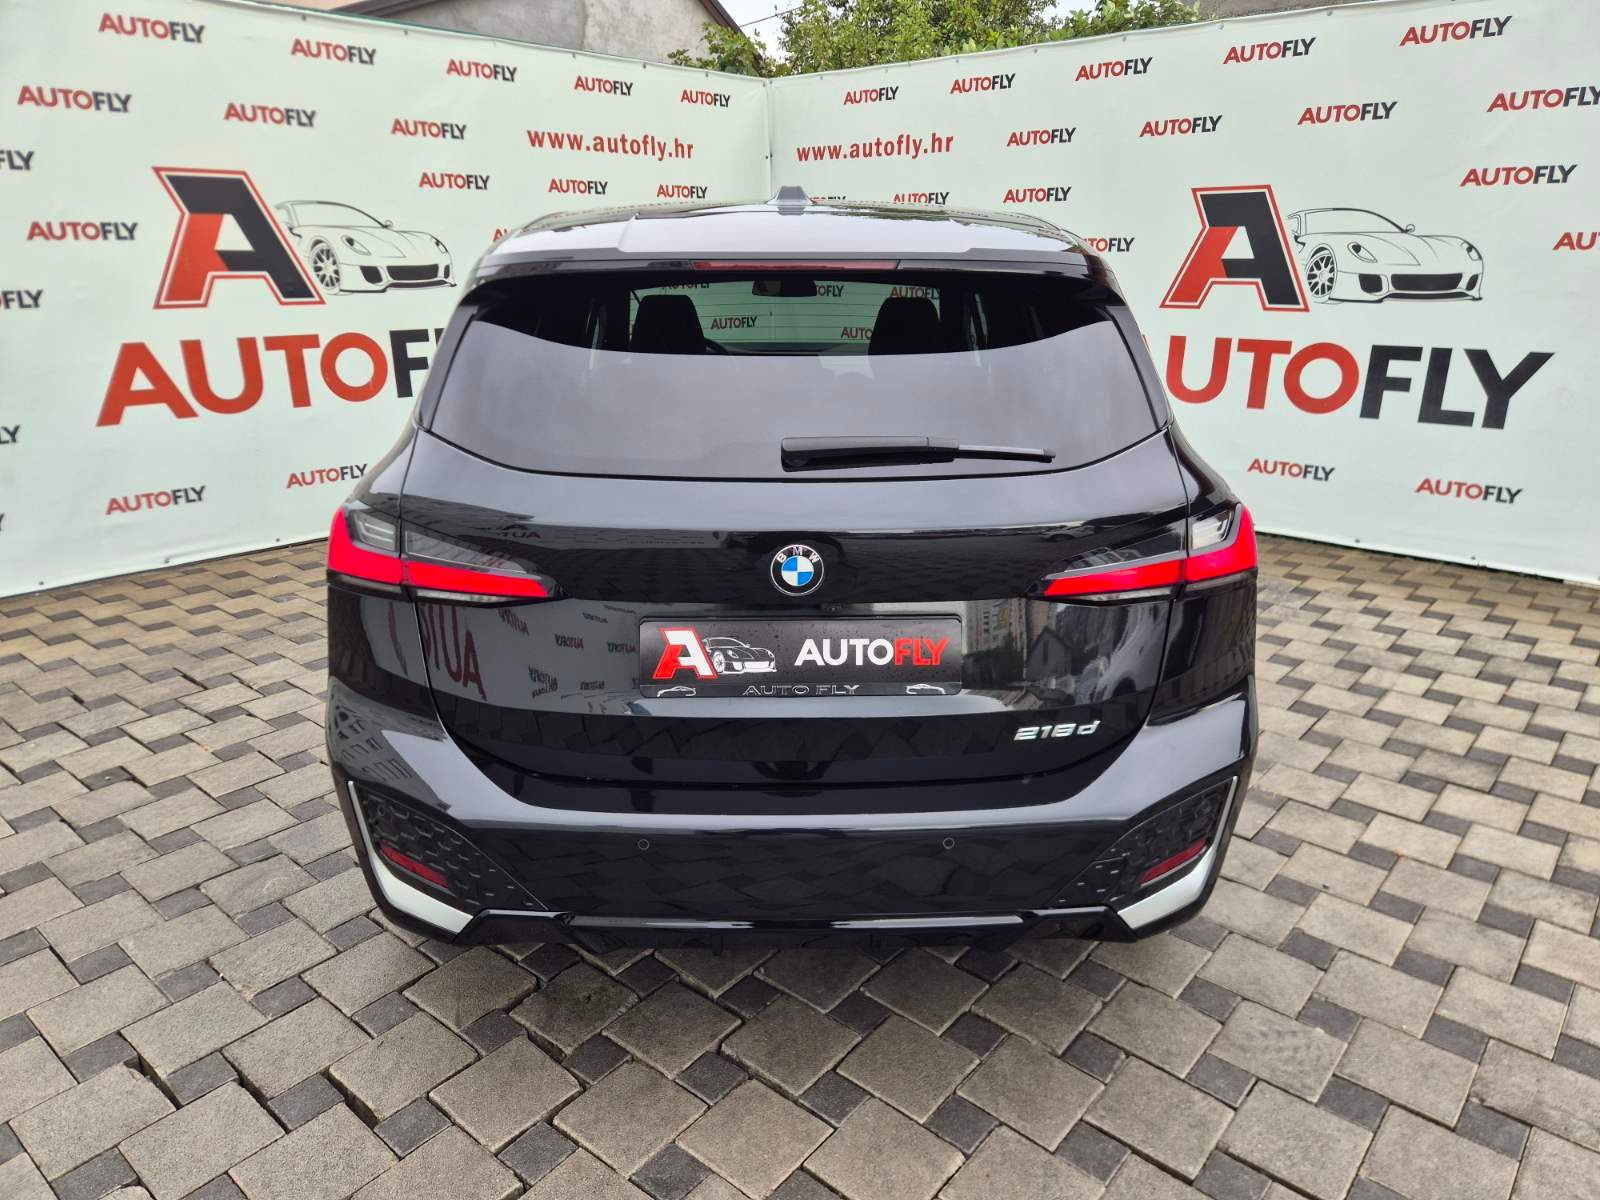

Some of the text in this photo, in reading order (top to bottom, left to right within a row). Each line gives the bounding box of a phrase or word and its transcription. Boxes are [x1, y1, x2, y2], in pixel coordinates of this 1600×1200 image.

[99, 13, 205, 43] AUTOFLY
[1400, 16, 1512, 46] AUTOFLY
[291, 39, 376, 65] AUTOFLY
[1223, 37, 1316, 64] AUTOFLY
[447, 59, 517, 82] AUTOFLY
[1075, 57, 1152, 81] AUTOFLY
[574, 76, 633, 96] AUTOFLY
[950, 73, 1015, 94] AUTOFLY
[18, 86, 131, 112] AUTOFLY
[681, 90, 730, 107] AUTOFLY
[844, 86, 899, 105] AUTOFLY
[224, 103, 316, 127] AUTOFLY
[1298, 101, 1397, 125] AUTOFLY
[392, 119, 466, 140] AUTOFLY
[1007, 128, 1076, 146] AUTOFLY
[1140, 115, 1222, 137] AUTOFLY
[527, 130, 693, 161] www.autofly.hr
[797, 133, 953, 161] www.autofly.hr
[419, 173, 489, 190] AUTOFLY
[1460, 164, 1577, 186] AUTOFLY
[549, 179, 608, 195] AUTOFLY
[657, 184, 708, 199] AUTOFLY
[1003, 187, 1071, 203] AUTOFLY
[894, 192, 949, 206] AUTOFLY
[27, 222, 138, 240] AUTOFLY
[1084, 237, 1135, 252] TOFLY
[710, 316, 758, 330] AUTOFLY
[96, 328, 445, 427] AUTOF
[1143, 334, 1555, 431] UTOFLY
[287, 463, 367, 488] AUTOFLY
[1248, 459, 1335, 481] AUTOFLY
[106, 486, 205, 515] AUTOFLY
[1416, 479, 1522, 504] AUTOFLY
[776, 546, 820, 564] BMW
[794, 638, 948, 667] AUTOFLY
[742, 684, 861, 696] AUTO FLY
[1014, 720, 1101, 741] 218d
